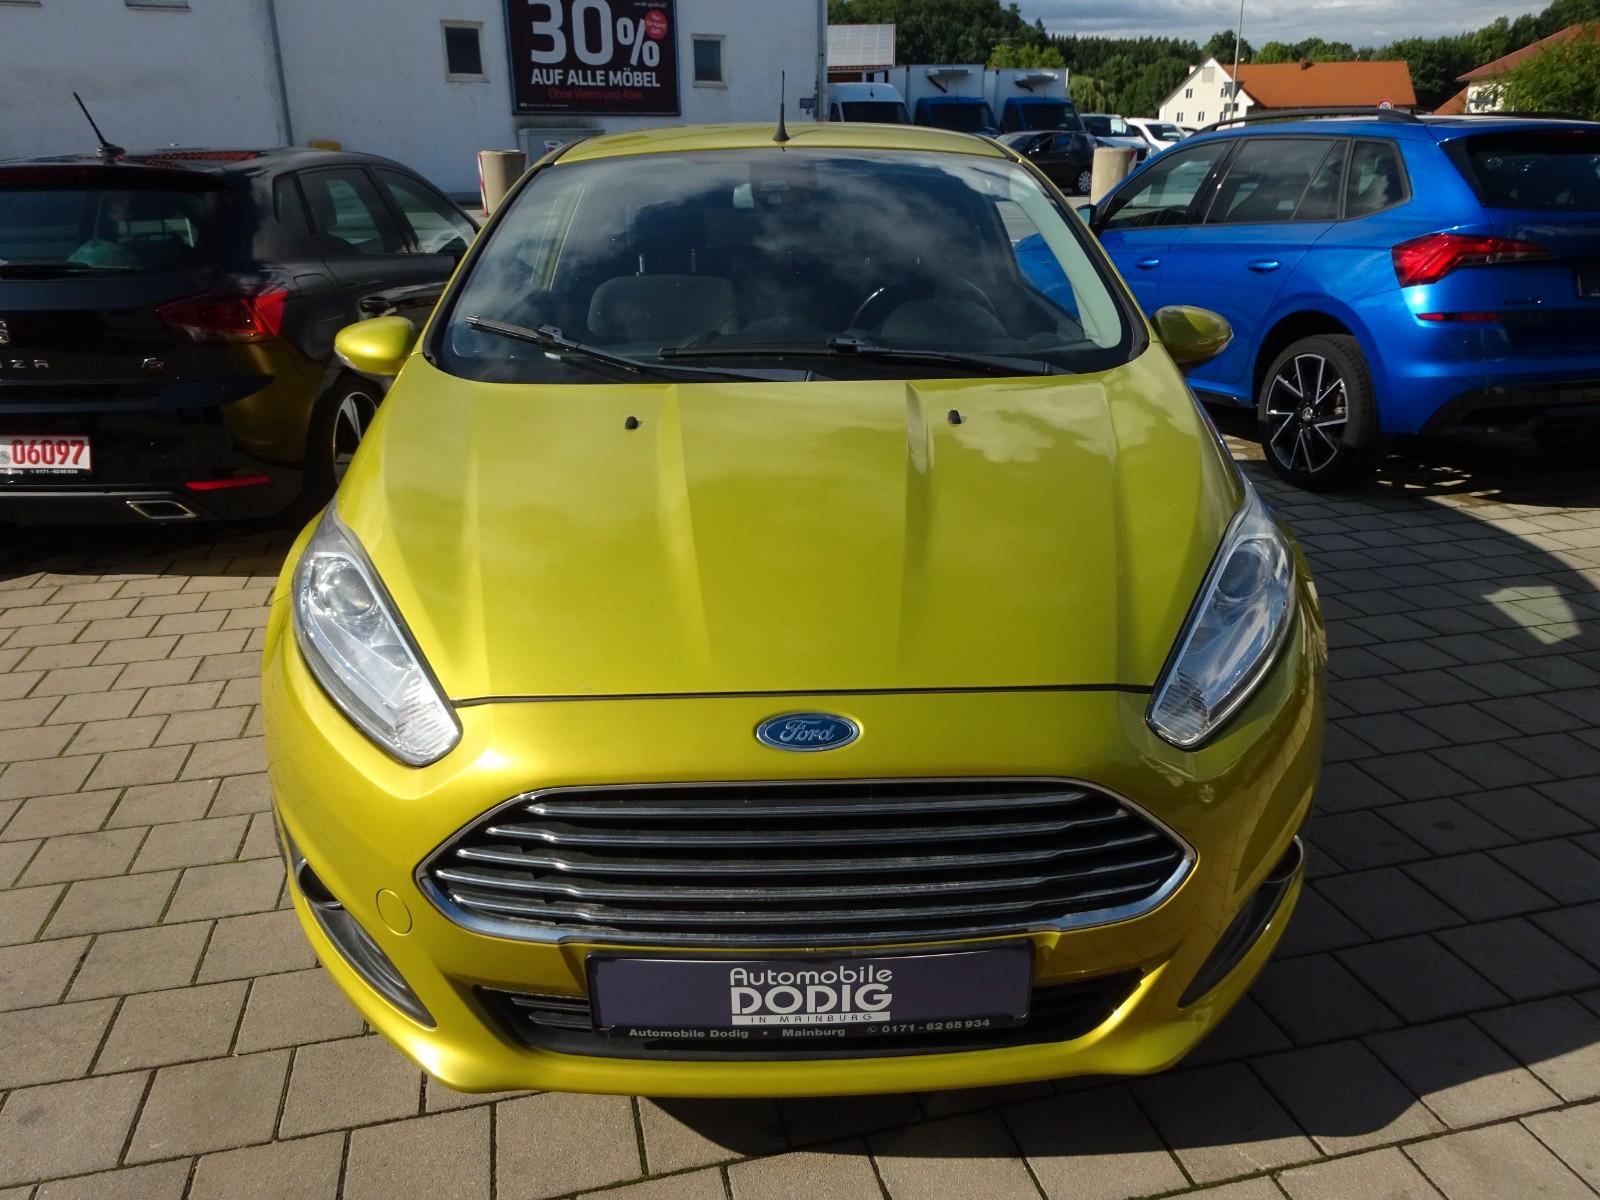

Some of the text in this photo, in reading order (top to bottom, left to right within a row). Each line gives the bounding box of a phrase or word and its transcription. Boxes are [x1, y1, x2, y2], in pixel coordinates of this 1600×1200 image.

[527, 0, 660, 67] 30%
[531, 67, 661, 87] AUF ALLE MÖBEL
[12, 440, 85, 465] 06097
[780, 720, 836, 742] Ford
[730, 965, 893, 985] Automobile
[731, 983, 893, 1014] DODIG
[779, 1013, 873, 1023] MAINBURG
[629, 1029, 705, 1038] Automobile
[710, 1029, 749, 1039] Dodig
[782, 1028, 846, 1037] Mainburg
